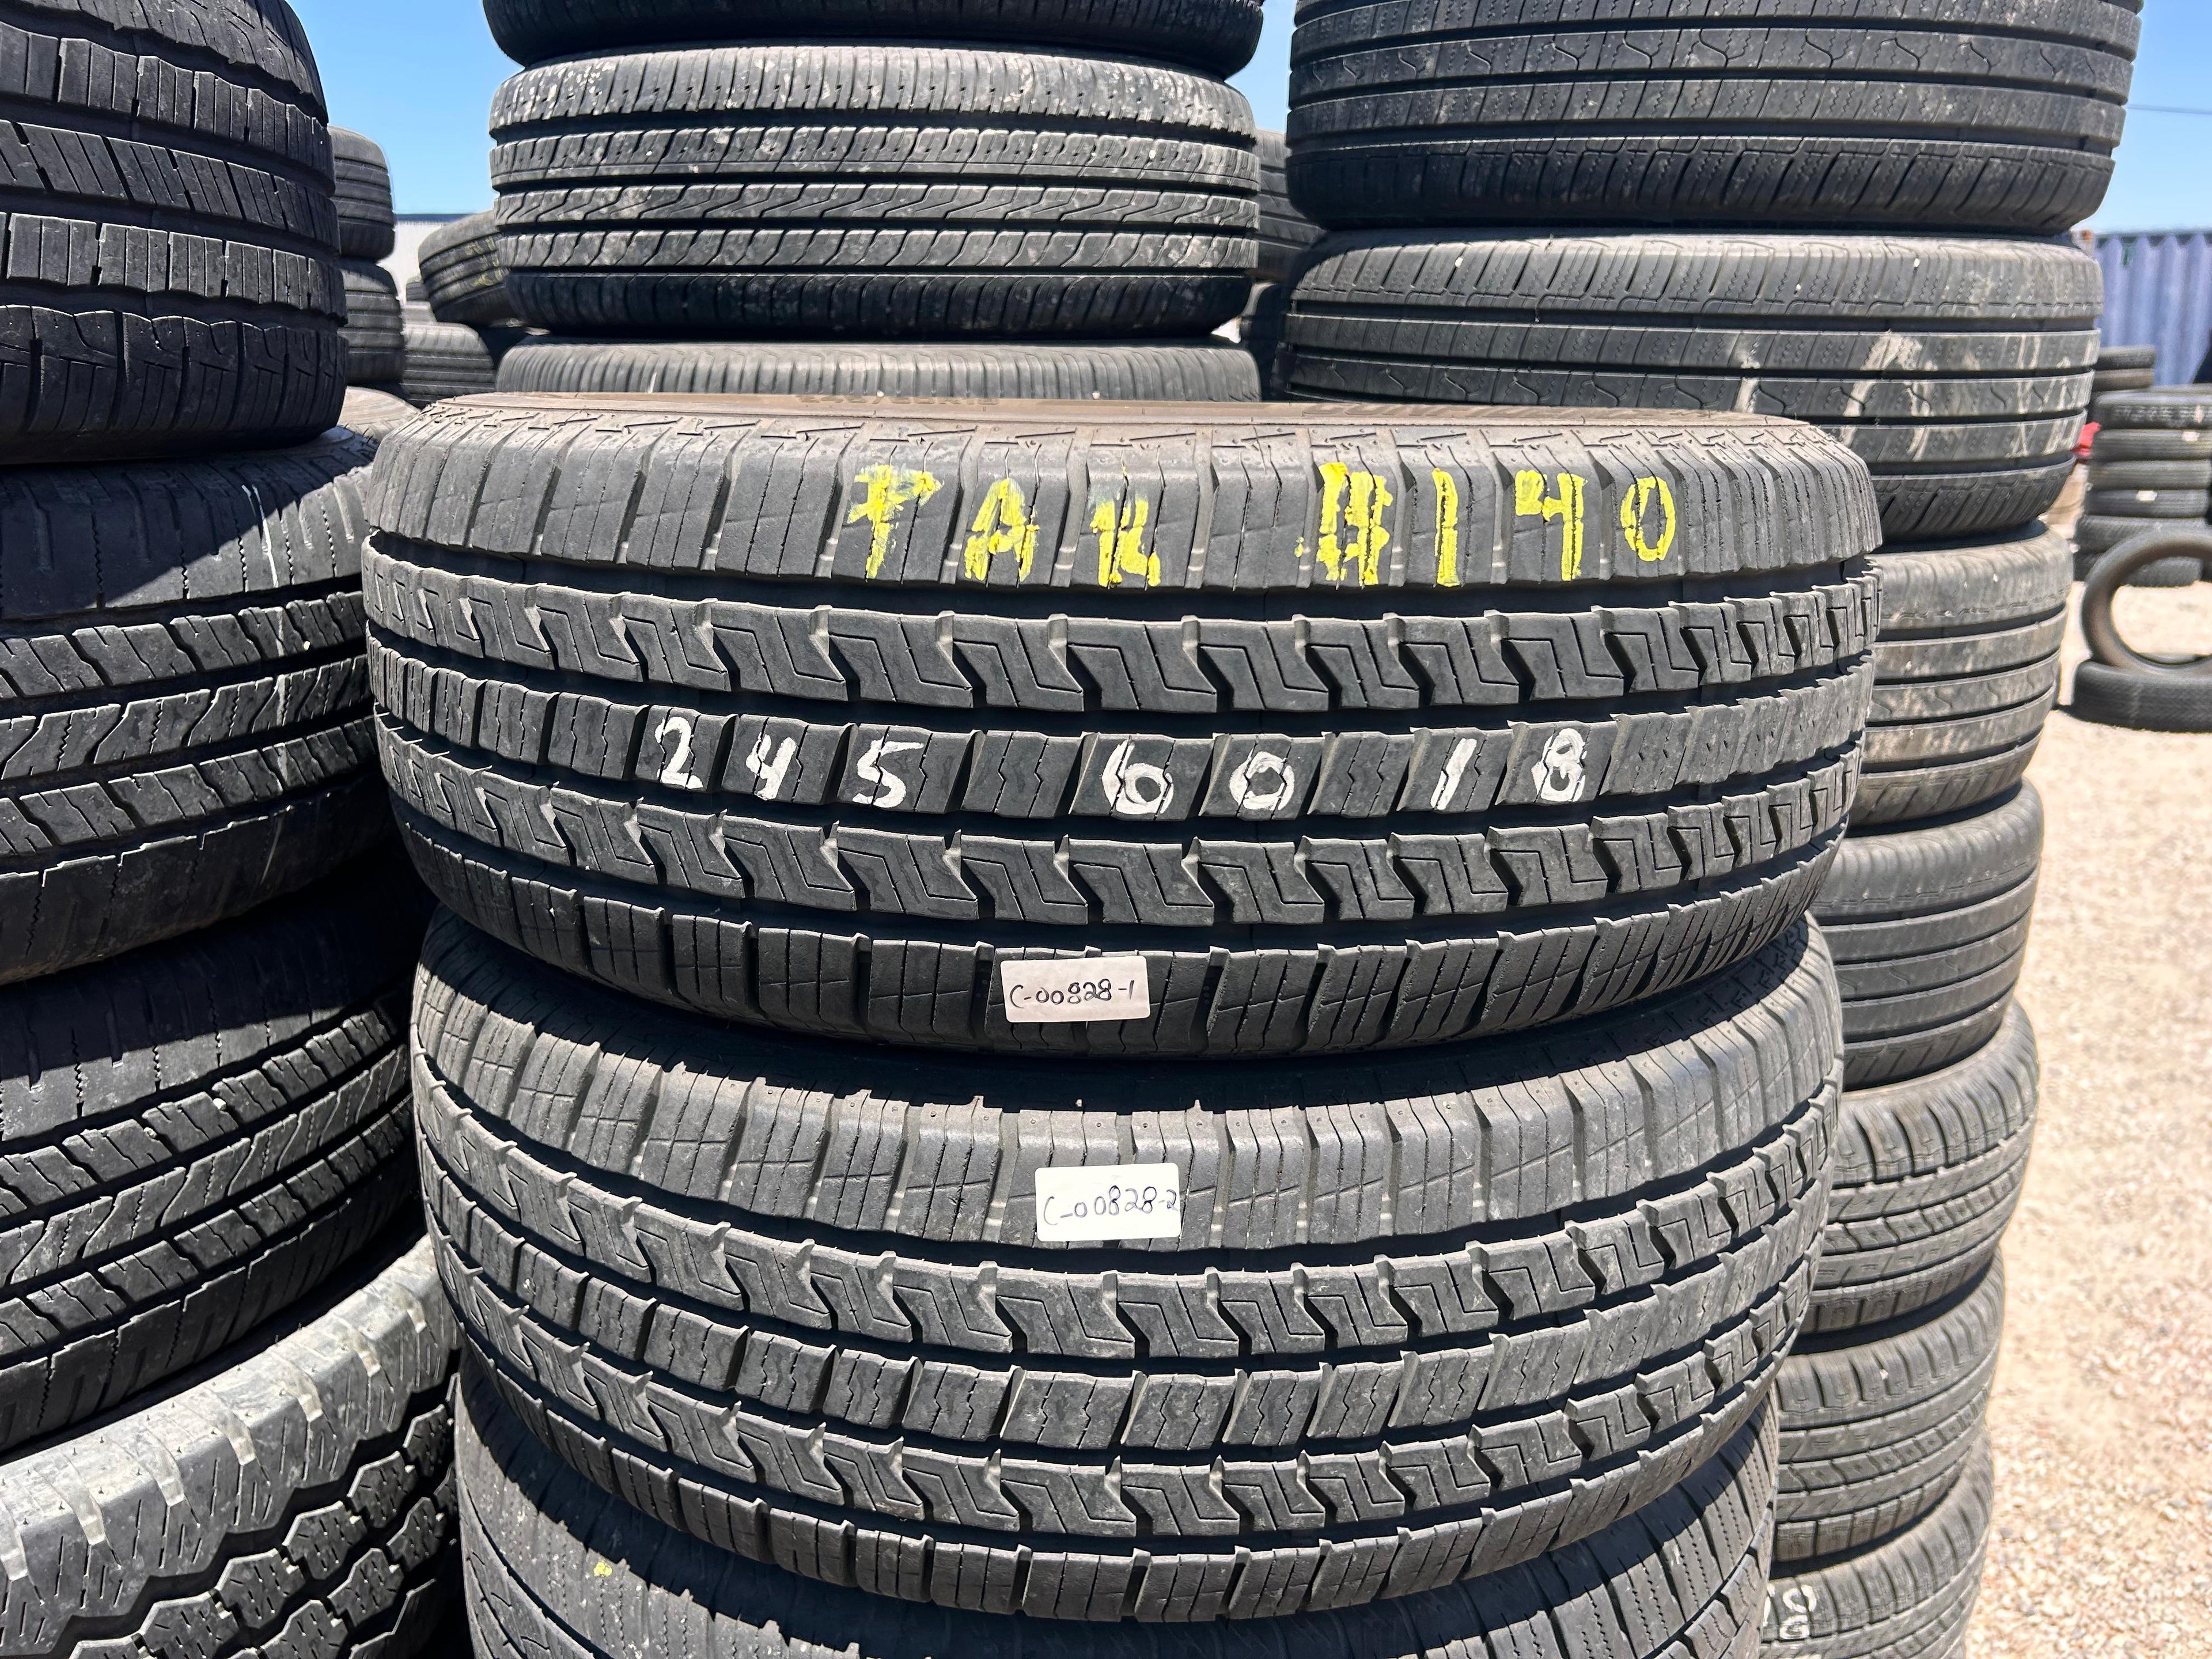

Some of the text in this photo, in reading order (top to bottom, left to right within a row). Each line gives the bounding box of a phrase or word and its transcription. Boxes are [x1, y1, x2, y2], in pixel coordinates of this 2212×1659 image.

[654, 717, 1586, 815] 245 60 18
[1009, 978, 1135, 1009] C-00828-1
